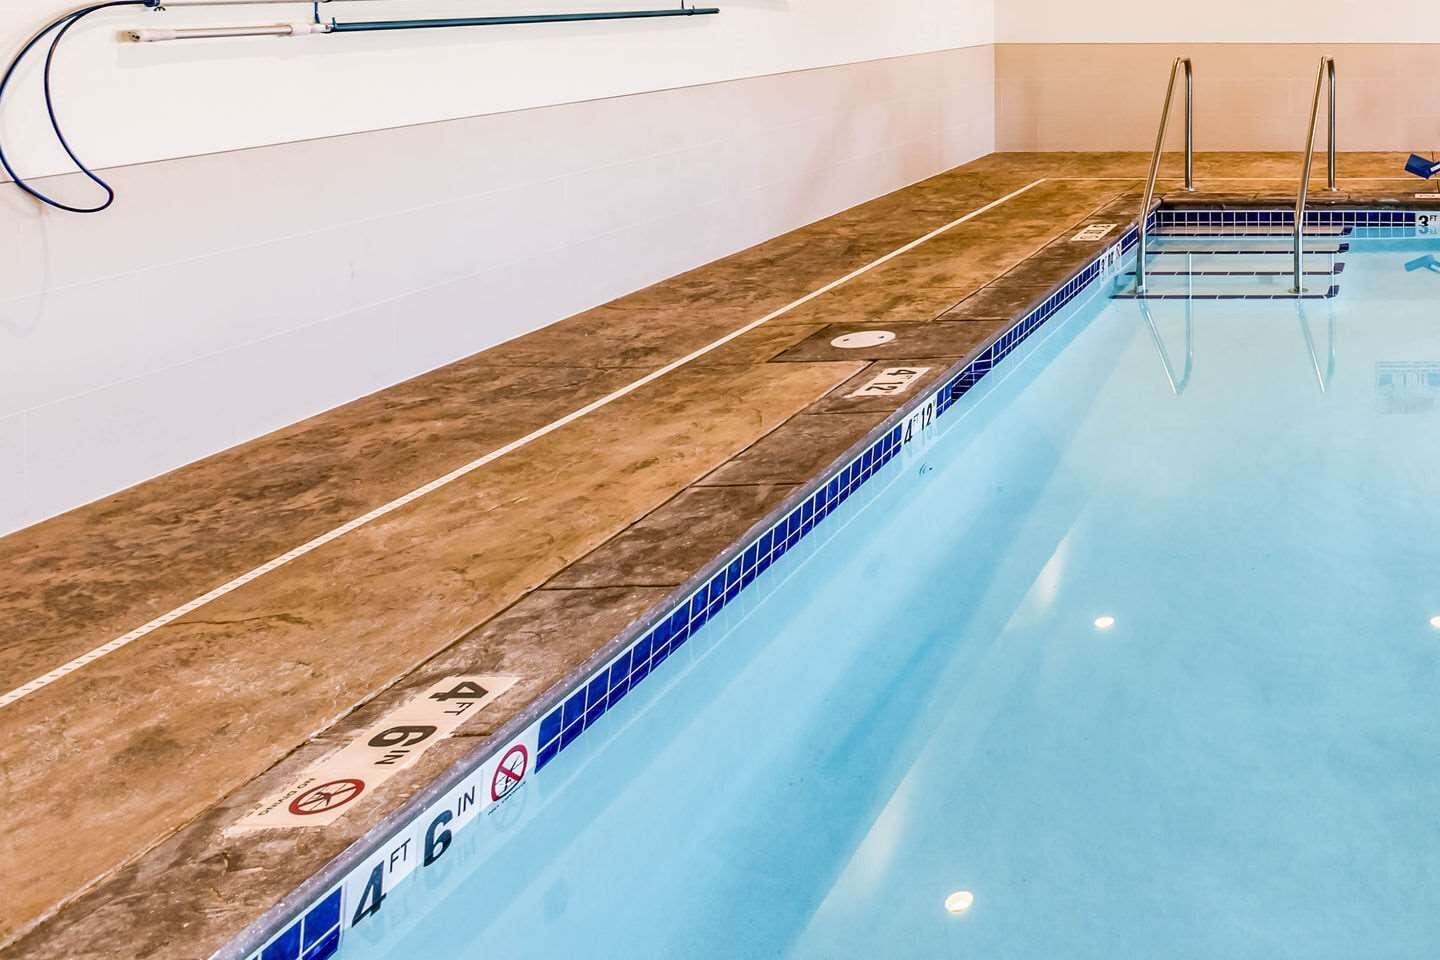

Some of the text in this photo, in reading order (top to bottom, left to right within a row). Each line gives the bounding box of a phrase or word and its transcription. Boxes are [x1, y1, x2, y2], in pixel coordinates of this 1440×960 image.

[903, 418, 913, 445] 4
[367, 680, 489, 766] 4 FT 6 IN
[351, 859, 387, 928] 4
[389, 838, 411, 873] FT
[423, 809, 453, 867] 6
[456, 785, 476, 817] IN
